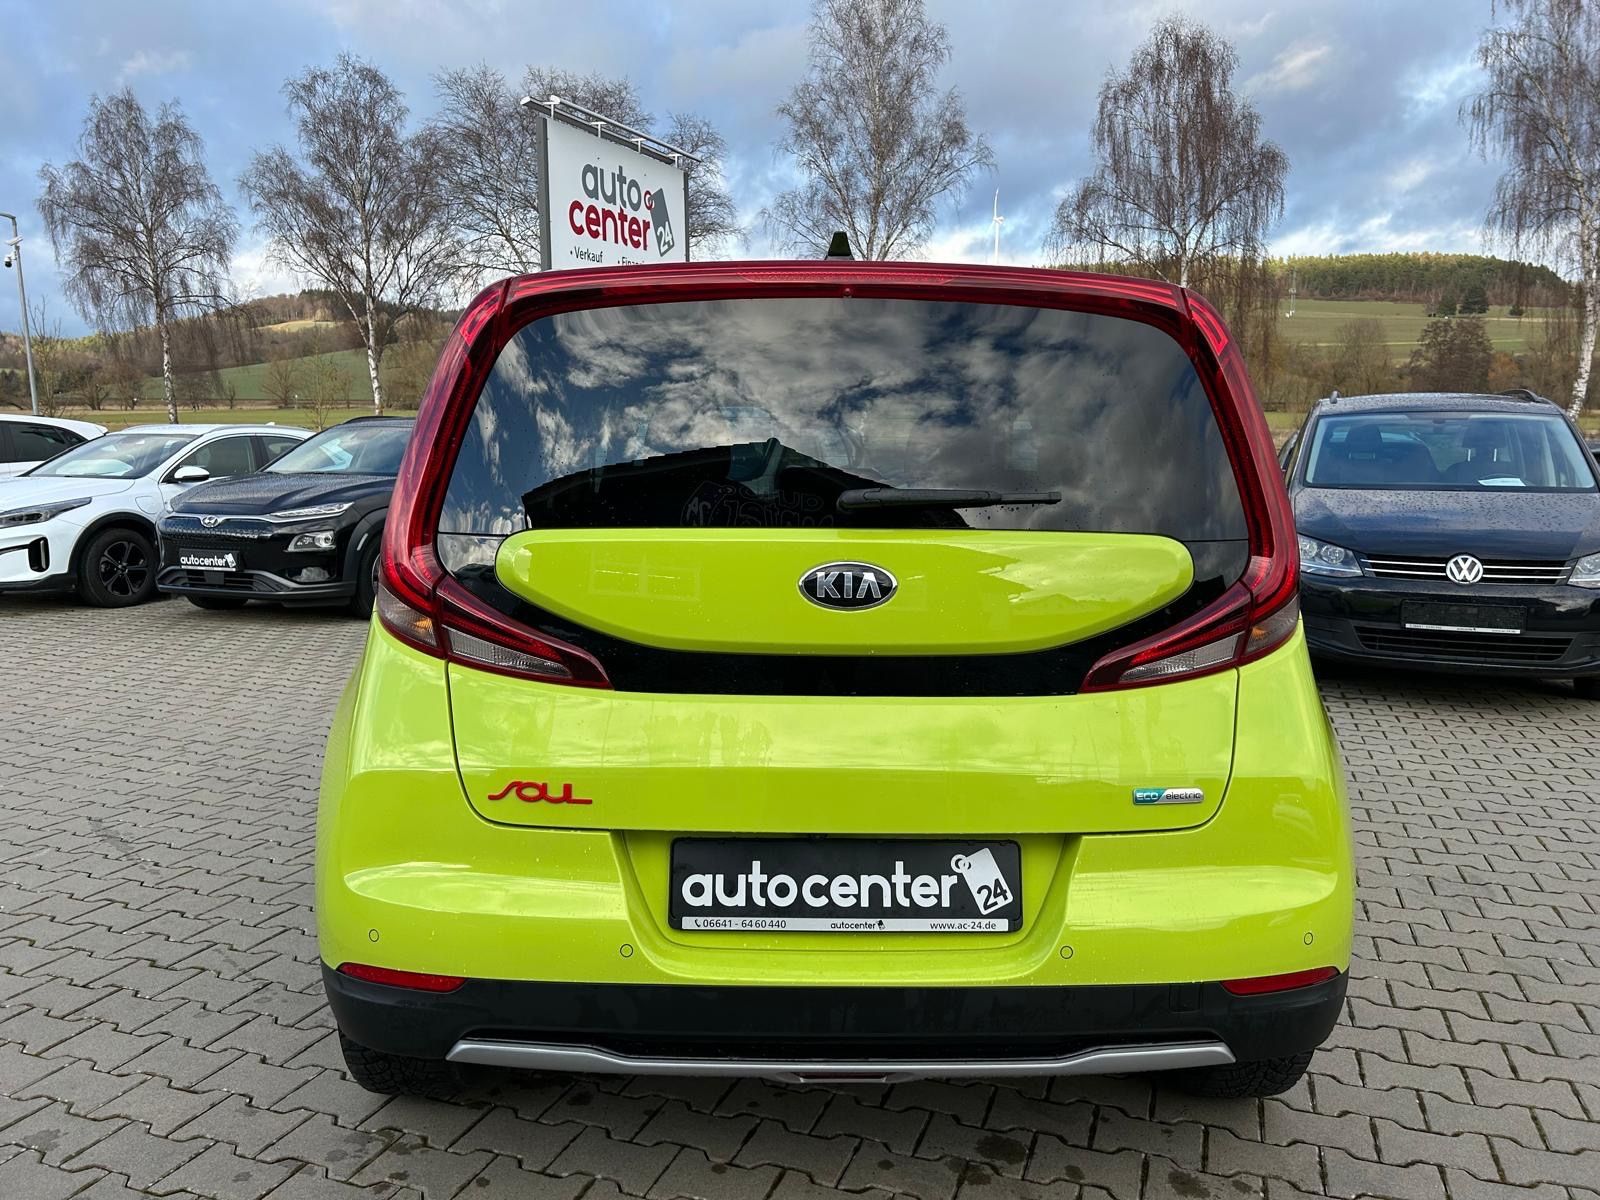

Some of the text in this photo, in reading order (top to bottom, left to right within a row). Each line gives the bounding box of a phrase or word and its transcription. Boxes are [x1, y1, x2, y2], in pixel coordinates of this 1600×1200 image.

[581, 163, 642, 212] auto
[569, 200, 651, 251] center
[656, 221, 674, 251] 24
[574, 246, 603, 264] Verkauf
[180, 554, 226, 567] autocenter
[815, 571, 882, 599] KIA
[1165, 791, 1202, 800] electric
[681, 860, 1009, 911] autocenter 24
[702, 918, 732, 928] 06641
[830, 921, 876, 930] autocenter
[929, 920, 997, 931] www.ac-24.de
